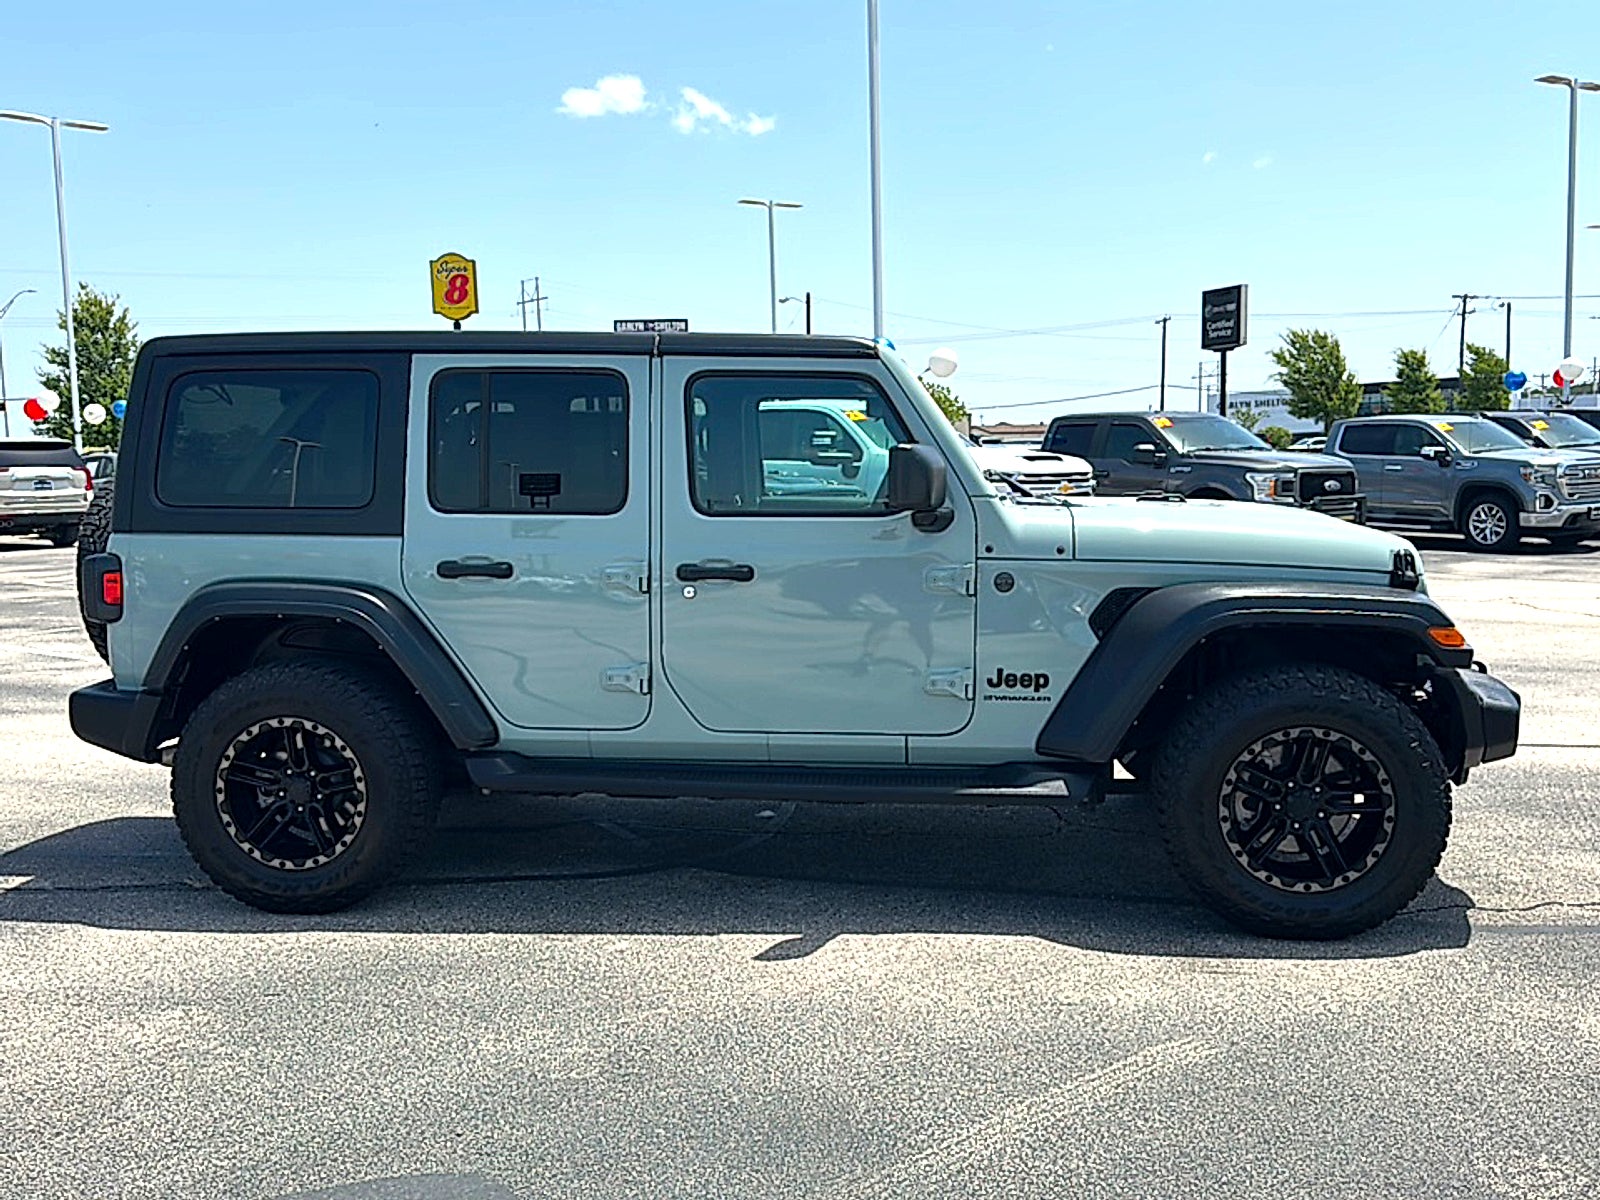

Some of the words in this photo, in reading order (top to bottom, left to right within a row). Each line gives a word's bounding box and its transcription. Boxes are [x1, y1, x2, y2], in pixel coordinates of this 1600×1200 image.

[436, 260, 468, 281] Super
[444, 273, 470, 306] 8
[1206, 319, 1235, 331] Certified
[1208, 328, 1232, 338] Service
[986, 667, 1050, 693] Jeep
